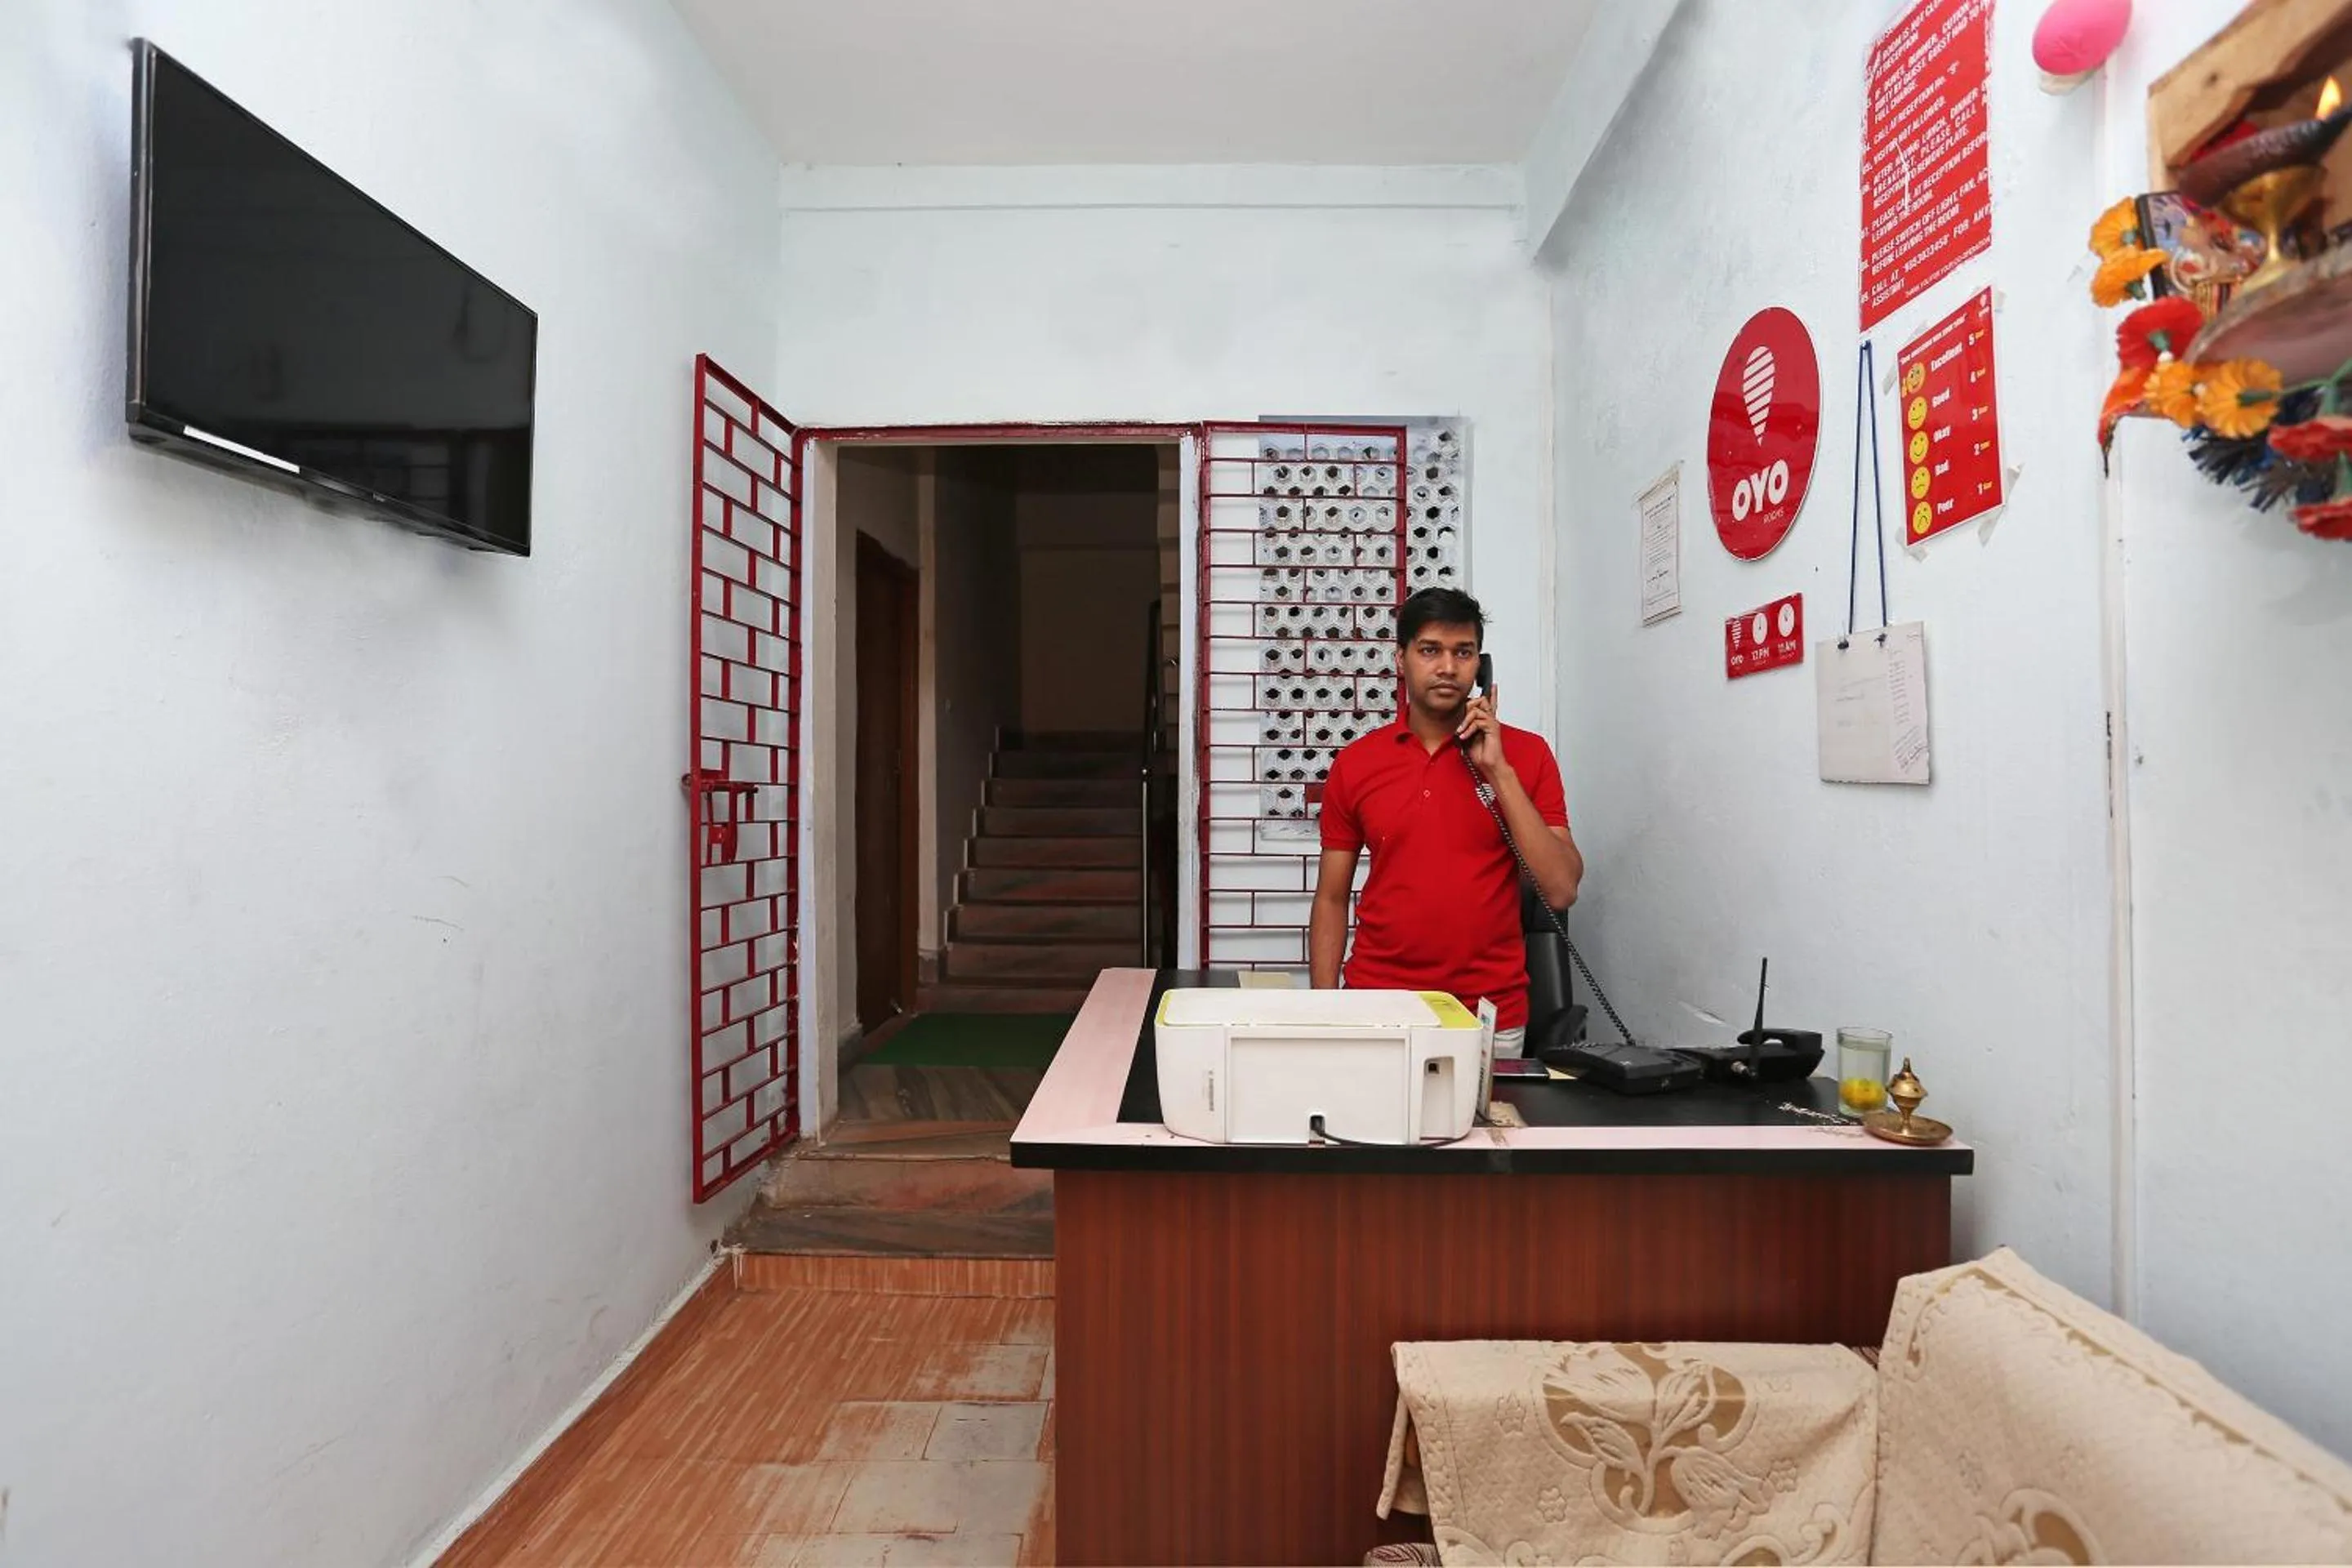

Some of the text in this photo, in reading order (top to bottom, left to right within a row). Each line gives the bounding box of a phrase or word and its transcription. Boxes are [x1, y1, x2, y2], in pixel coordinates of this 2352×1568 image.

[1954, 104, 1977, 128] CALL
[1922, 153, 1961, 191] RECEPTION
[1953, 217, 1970, 239] FOR
[1931, 341, 1962, 372] Excellent
[1968, 332, 1976, 346] 5
[1971, 408, 1979, 421] 3
[1973, 442, 1980, 457] 2
[1732, 458, 1789, 522] OYO
[1977, 482, 1984, 496] 1
